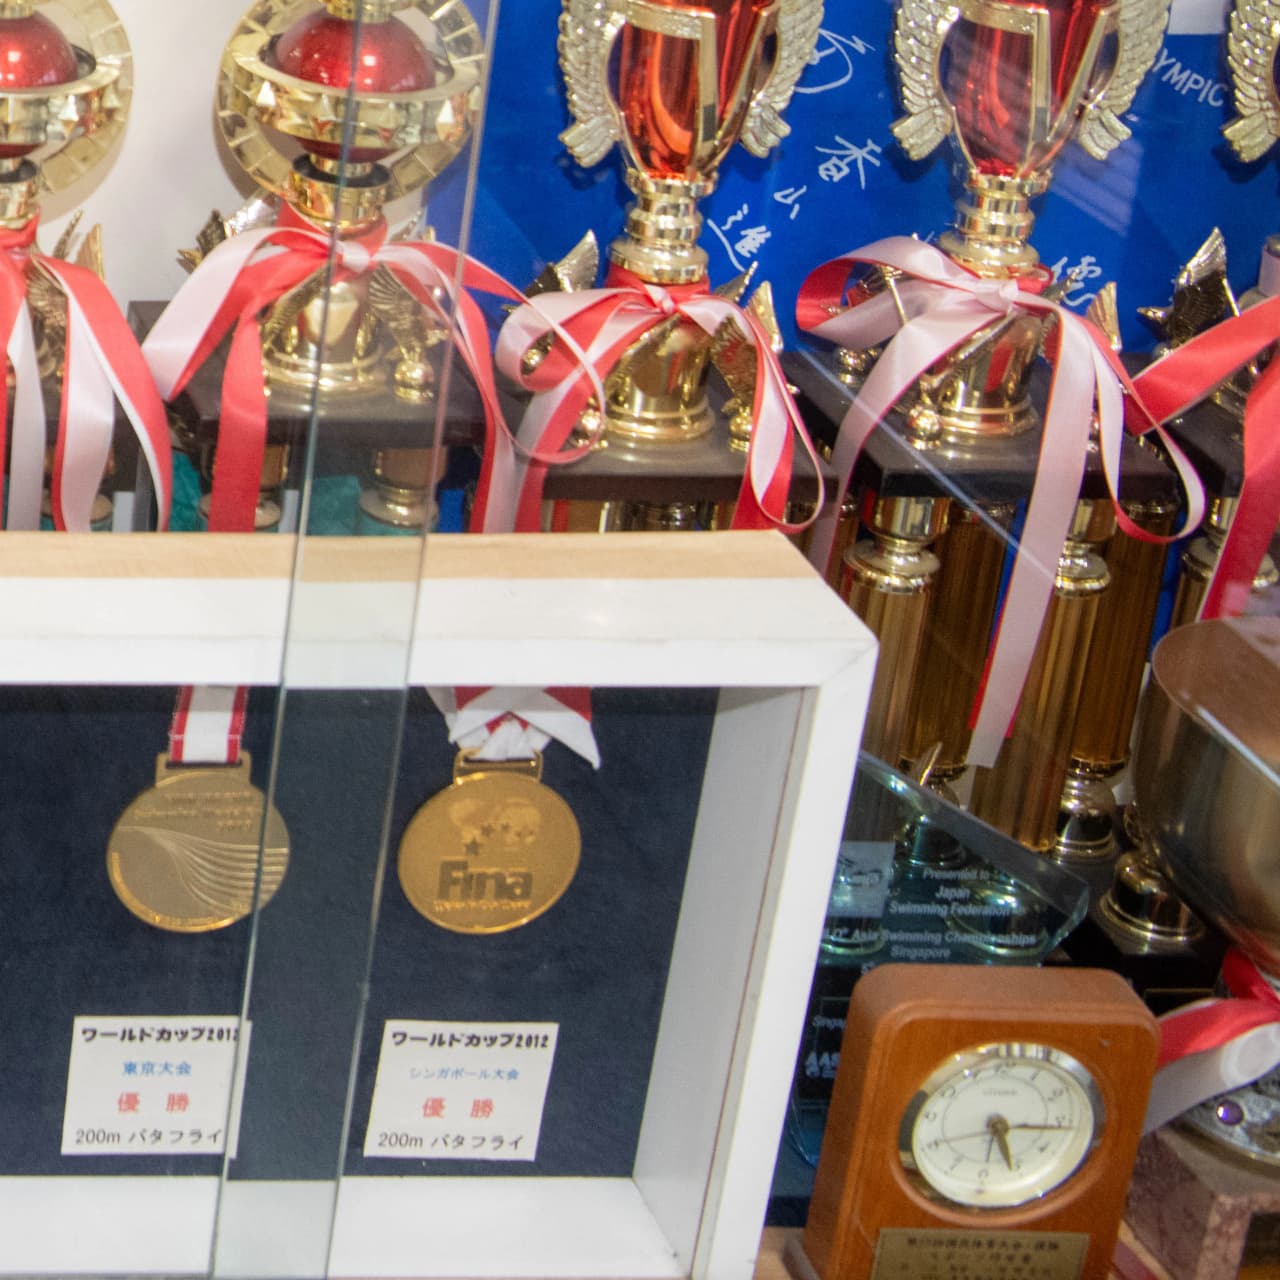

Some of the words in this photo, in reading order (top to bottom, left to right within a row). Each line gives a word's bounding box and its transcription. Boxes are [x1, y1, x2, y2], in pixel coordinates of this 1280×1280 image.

[438, 860, 533, 899] Fina
[936, 888, 970, 901] Japan
[890, 902, 948, 917] Swimming
[891, 946, 950, 960] Singapore
[392, 1032, 549, 1048] ワールドカップ2012
[122, 1061, 191, 1077] 東京大会
[117, 1092, 190, 1113] 優勝
[422, 1097, 494, 1119] 優勝
[75, 1129, 121, 1144] 200m
[129, 1129, 222, 1145] バタフライ
[378, 1132, 423, 1149] 200m
[431, 1135, 523, 1151] バタフライ
